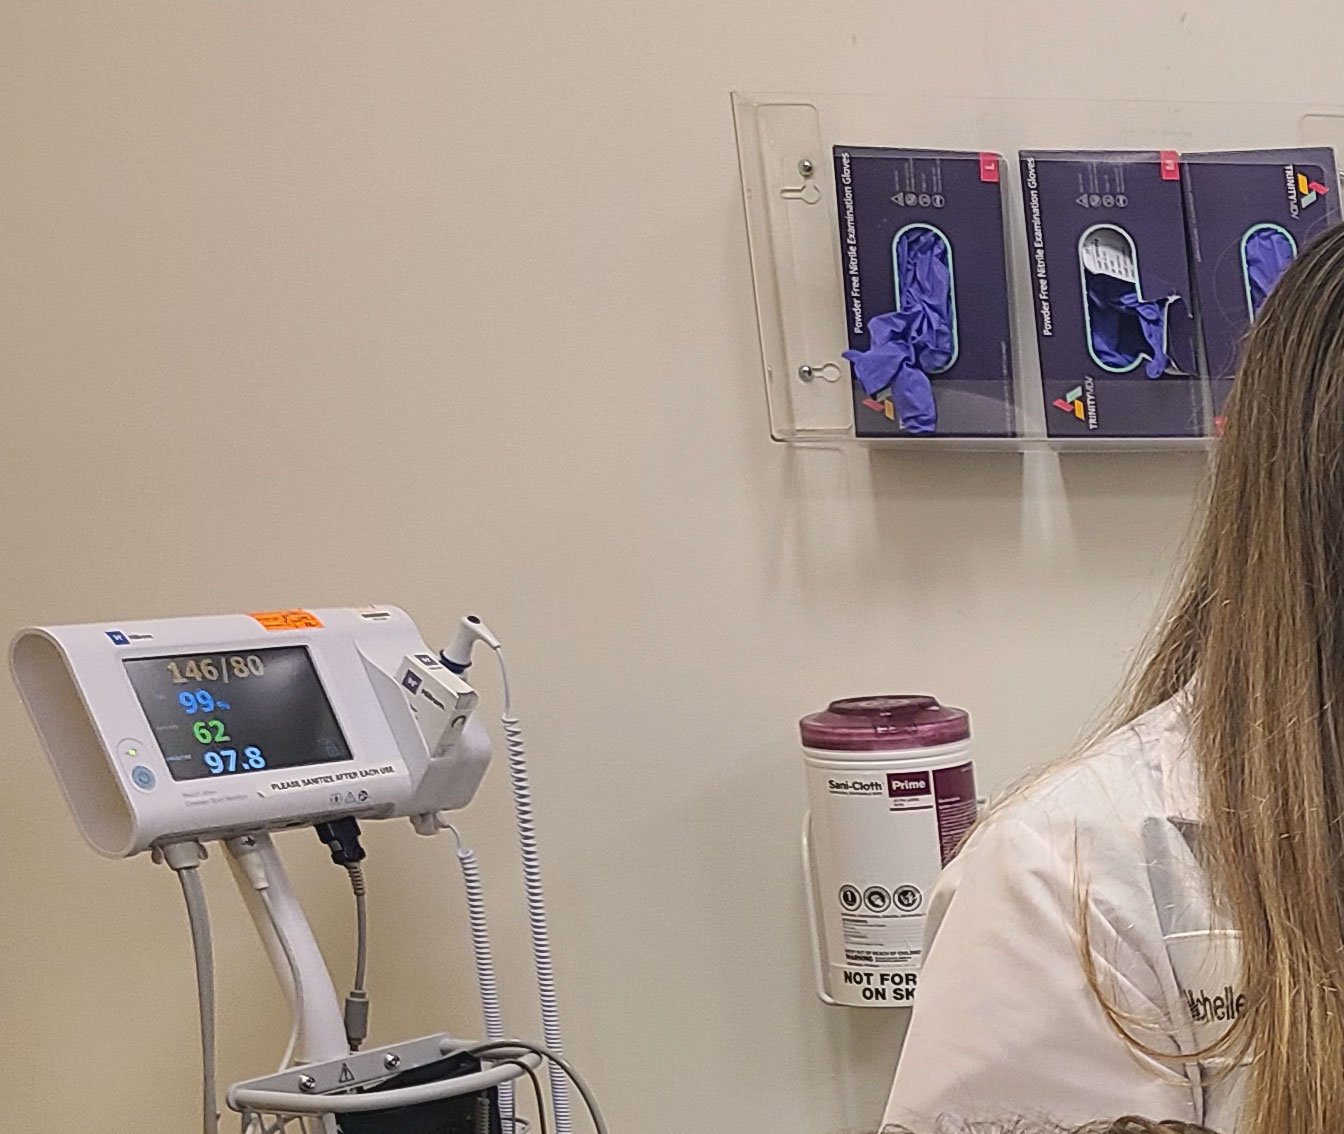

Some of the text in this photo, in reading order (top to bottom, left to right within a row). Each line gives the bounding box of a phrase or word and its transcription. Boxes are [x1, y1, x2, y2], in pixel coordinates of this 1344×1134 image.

[841, 152, 863, 334] Powder Free Nitrile Examination Gloves
[1027, 157, 1053, 336] Powder Free Nitrile Examination Gloves
[167, 654, 265, 684] 146/80
[192, 719, 232, 744] 62
[203, 745, 266, 774] 97.8
[271, 780, 300, 791] PLEASE
[336, 771, 358, 782] AFTER
[360, 768, 379, 779] EACH
[828, 779, 926, 791] Sani-Cloth Prime
[843, 970, 917, 986] NOT FOR
[862, 987, 886, 1000] ON
